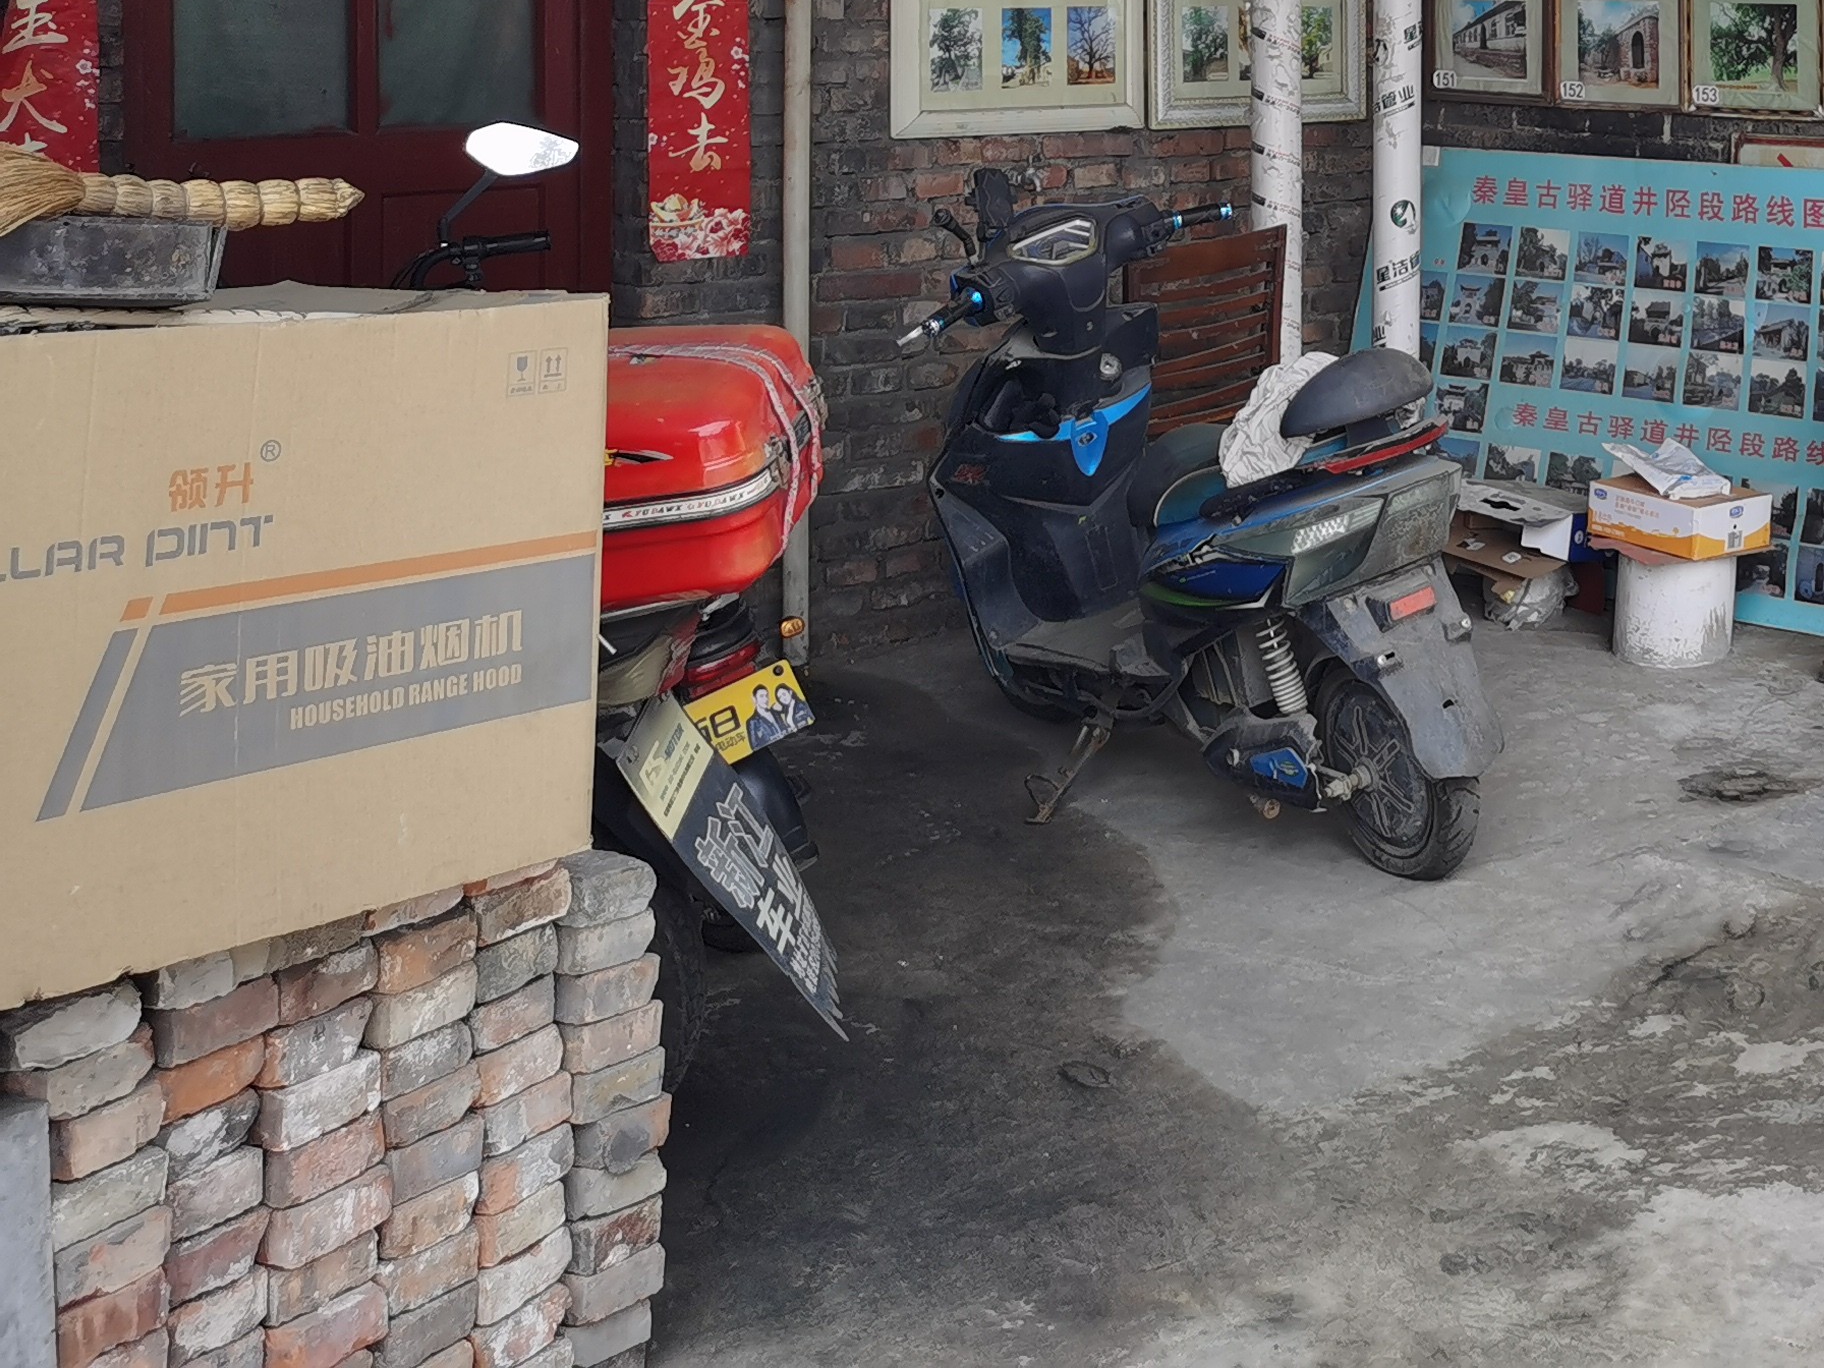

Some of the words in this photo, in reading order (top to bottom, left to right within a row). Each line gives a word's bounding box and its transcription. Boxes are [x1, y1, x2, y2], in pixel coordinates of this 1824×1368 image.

[1435, 72, 1456, 87] 151
[1561, 82, 1583, 97] 152
[1695, 88, 1717, 102] 153
[168, 462, 254, 512] 领升
[179, 609, 523, 718] 家用吸油烟机
[290, 688, 404, 730] HOUSEHOLD
[409, 675, 468, 707] RANGE
[473, 663, 522, 690] HOOD
